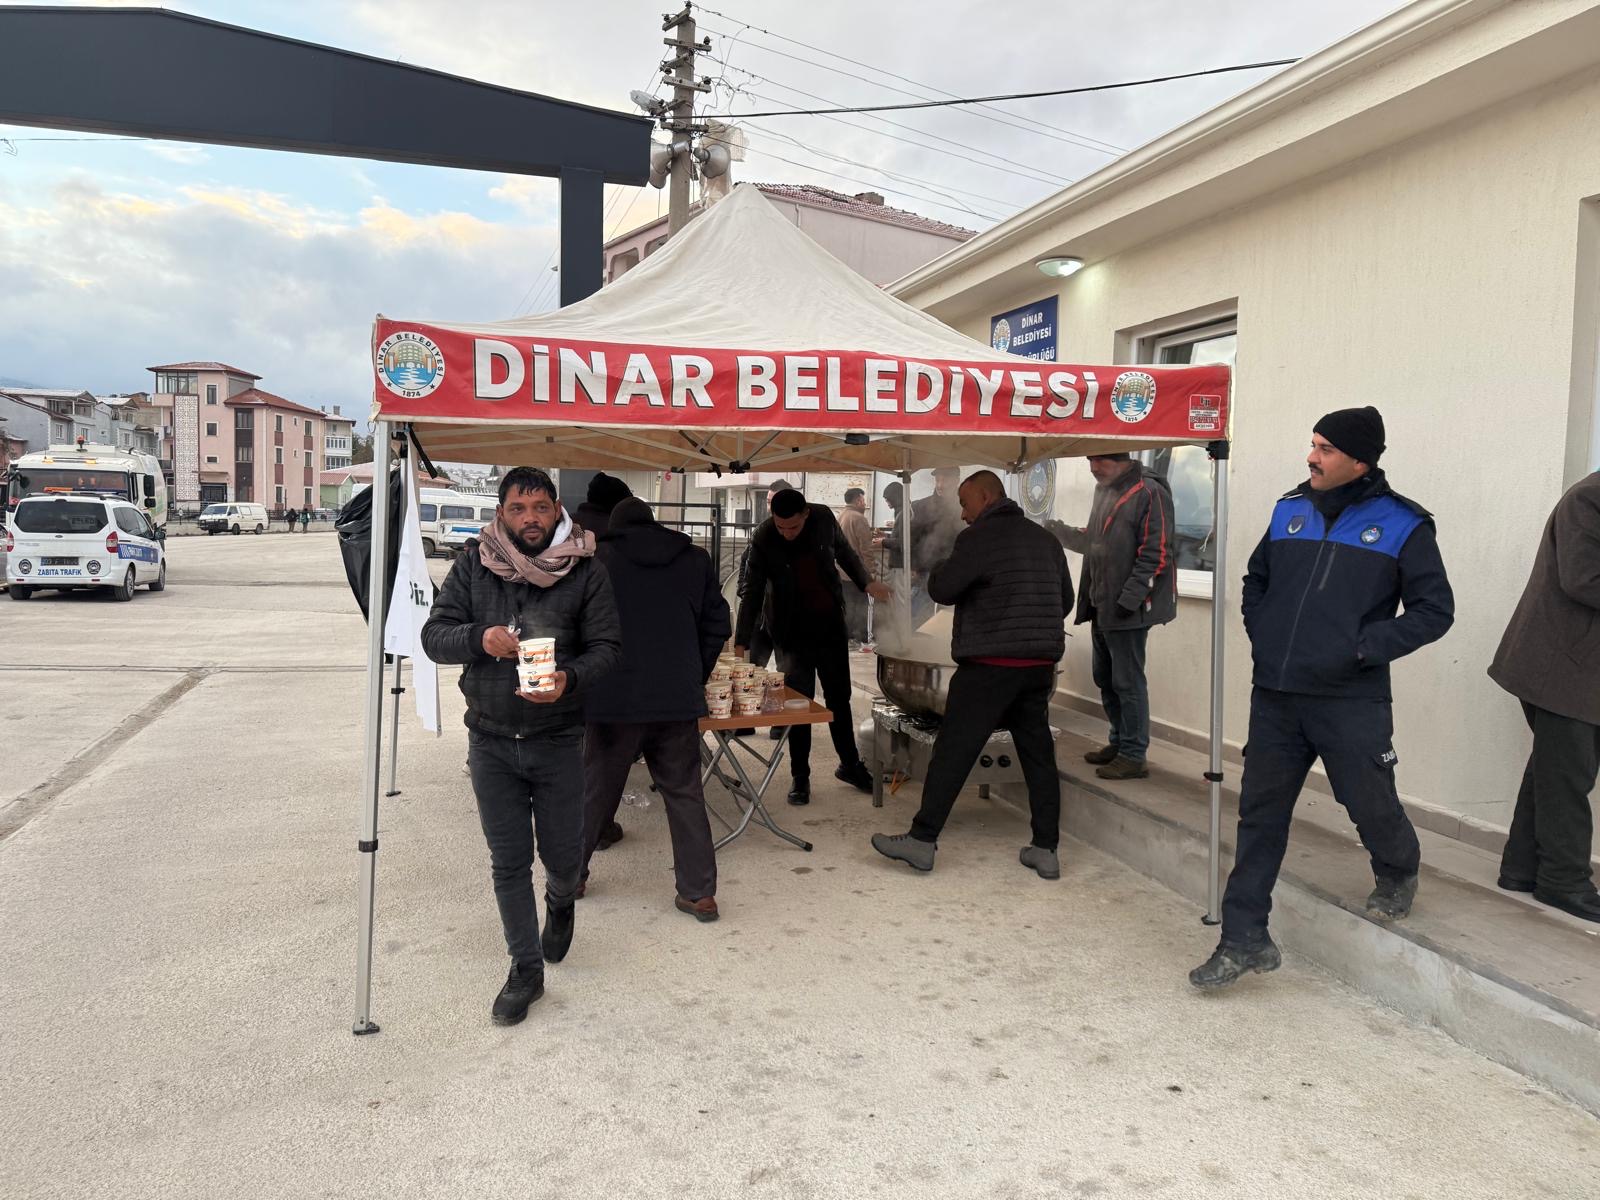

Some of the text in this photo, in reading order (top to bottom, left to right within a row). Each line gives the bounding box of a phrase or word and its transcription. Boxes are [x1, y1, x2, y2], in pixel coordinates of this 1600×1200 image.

[1021, 312, 1043, 329] DİNAR
[1013, 323, 1052, 347] BELEDİYESİ
[474, 338, 1100, 419] DİNAR BELEDİYESİ
